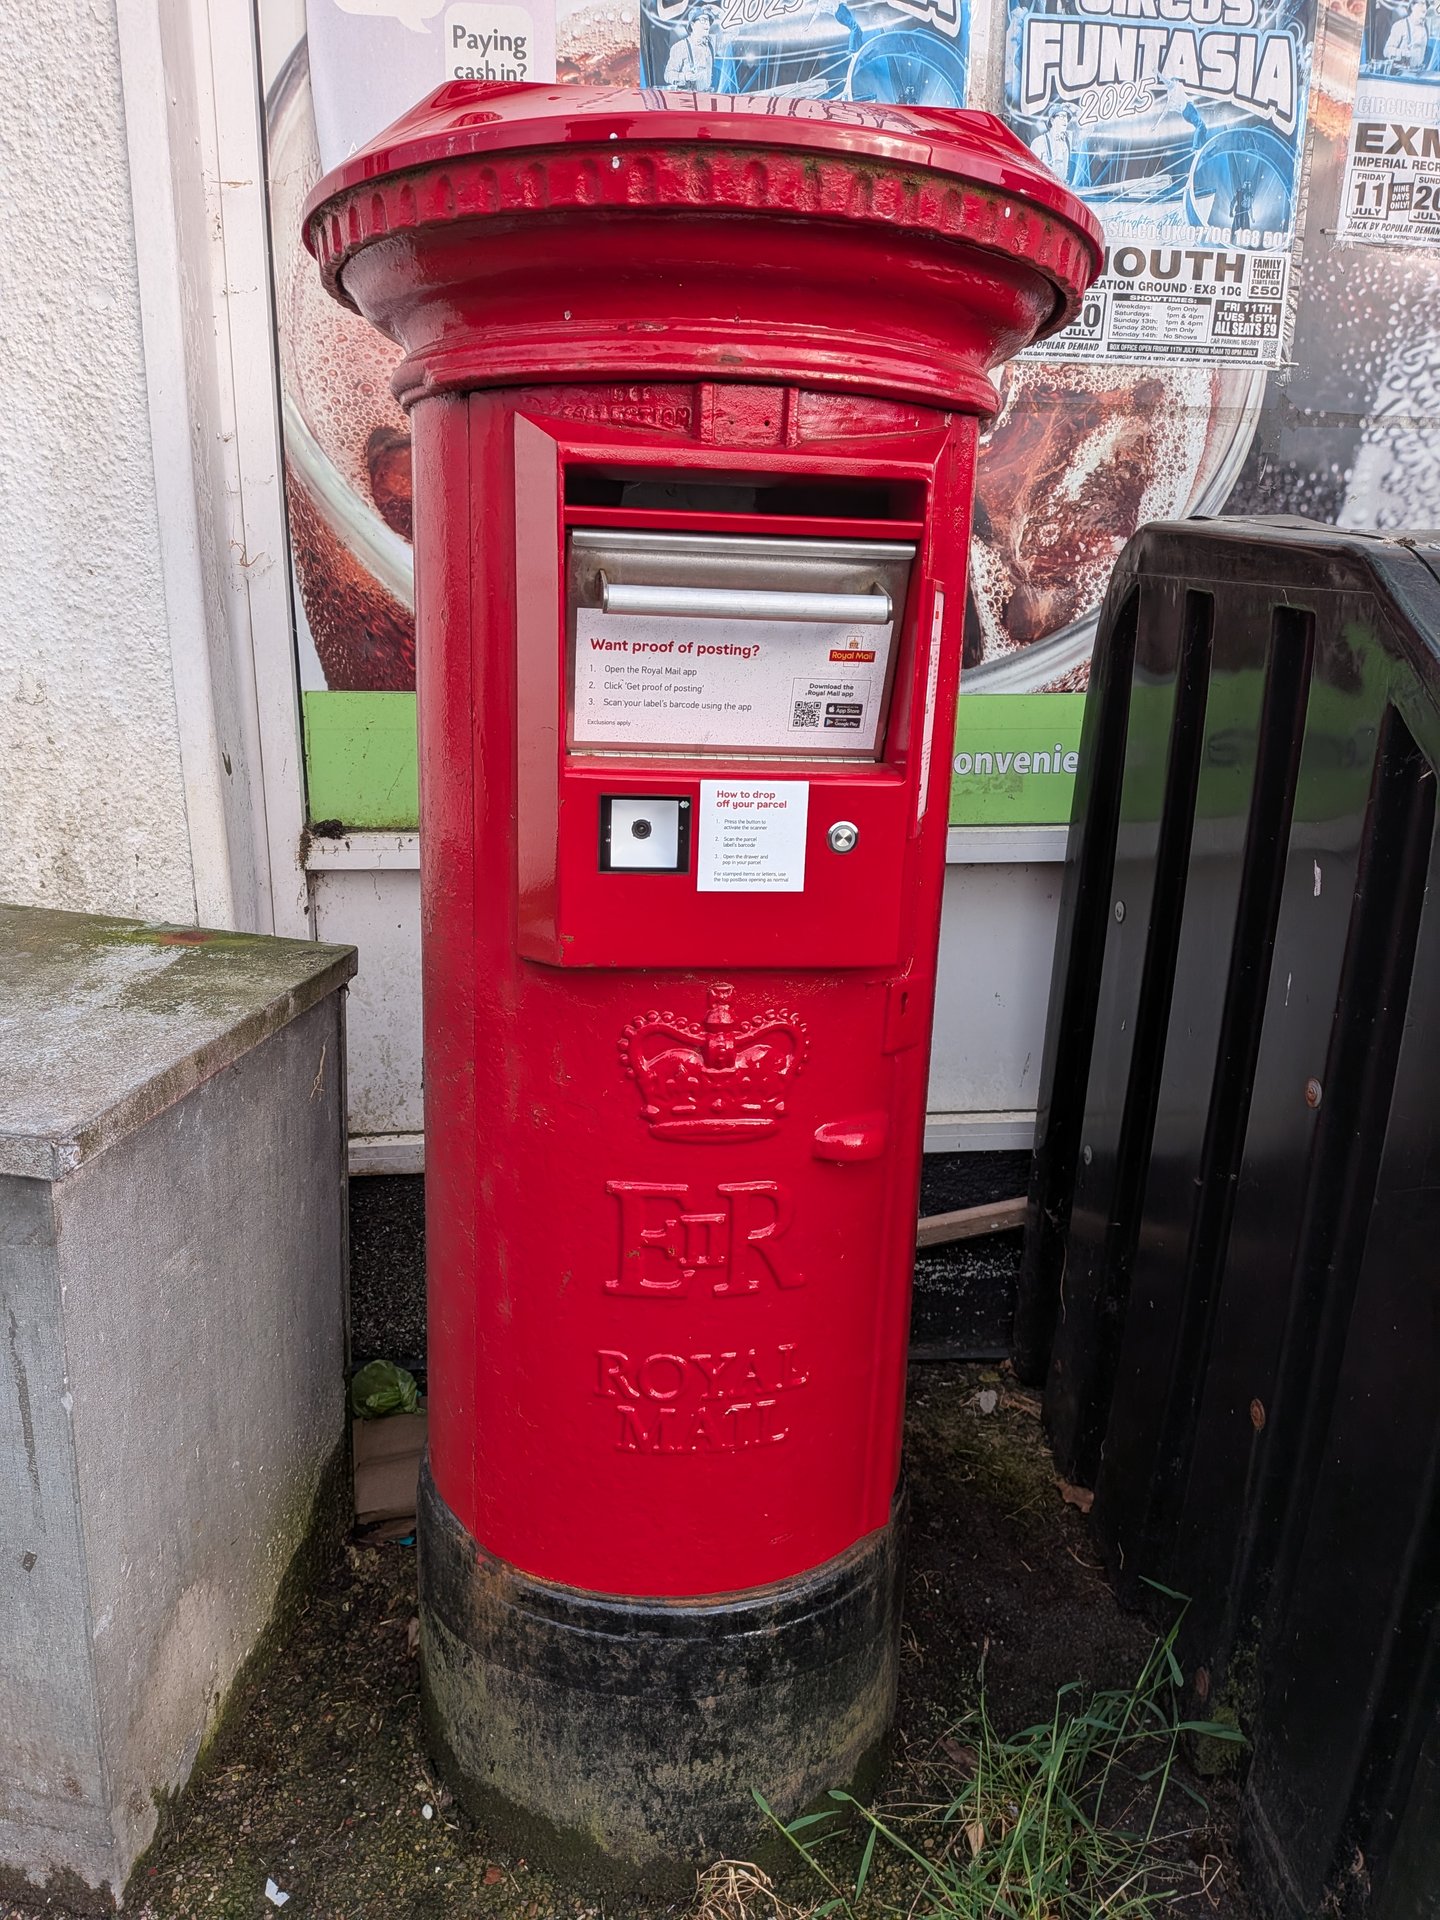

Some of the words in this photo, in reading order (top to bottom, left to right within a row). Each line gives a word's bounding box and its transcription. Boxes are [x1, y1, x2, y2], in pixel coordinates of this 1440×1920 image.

[452, 24, 527, 60] Paying
[453, 60, 497, 80] cash
[500, 63, 528, 81] in?
[1026, 19, 1295, 118] FUNTASIA
[1078, 78, 1156, 126] 2025
[1353, 156, 1408, 170] IMPERIAL
[1357, 173, 1386, 181] FRIDAY
[1355, 181, 1384, 207] 11
[1390, 201, 1410, 209] ONLY!
[1353, 208, 1381, 216] JULY
[1381, 223, 1414, 232] POPULAR
[1101, 246, 1245, 283] OUTH
[1253, 259, 1281, 269] FAMILY
[1252, 269, 1281, 279] TICKET
[1138, 281, 1188, 293] GROUND
[1194, 285, 1216, 295] EX8
[1221, 286, 1242, 297] 1DG
[1250, 286, 1280, 295] £50
[1129, 295, 1197, 304] SHOWTIMES:
[1224, 302, 1240, 311] FRI
[1244, 303, 1273, 313] 11TH
[1217, 312, 1245, 321] TUES
[1249, 313, 1277, 323] 15TH
[1065, 328, 1095, 337] JULY
[1214, 321, 1230, 334] ALL
[1232, 322, 1261, 336] SEATS
[1263, 323, 1277, 337] £9
[1067, 342, 1100, 351] DEMAND
[1243, 349, 1257, 357] DAILY
[590, 638, 628, 651] Want
[632, 641, 674, 654] proof
[678, 642, 693, 653] of
[697, 644, 760, 659] posting?
[832, 651, 854, 660] Royal
[856, 652, 873, 660] Mail
[590, 665, 596, 673] 1.
[604, 665, 625, 675] Open
[626, 665, 639, 674] the
[641, 666, 662, 675] Royal
[664, 667, 681, 675] Mail
[683, 668, 697, 676] app
[588, 681, 595, 689] 2.
[604, 681, 623, 690] Click
[641, 682, 662, 692] proof
[664, 683, 673, 691] of
[588, 698, 595, 706] 3.
[603, 698, 622, 707] Scan
[624, 700, 641, 708] your
[669, 700, 700, 709] barcode
[701, 702, 722, 711] using
[724, 702, 736, 711] the
[737, 704, 752, 712] app
[954, 743, 1079, 775] onvenie
[716, 790, 738, 798] How
[740, 791, 750, 799] to
[752, 791, 776, 800] drop
[716, 800, 730, 808] off
[732, 801, 754, 810] your
[757, 800, 787, 810] parcel
[594, 1343, 809, 1400] ROYAL
[615, 1399, 788, 1454] MAIL
